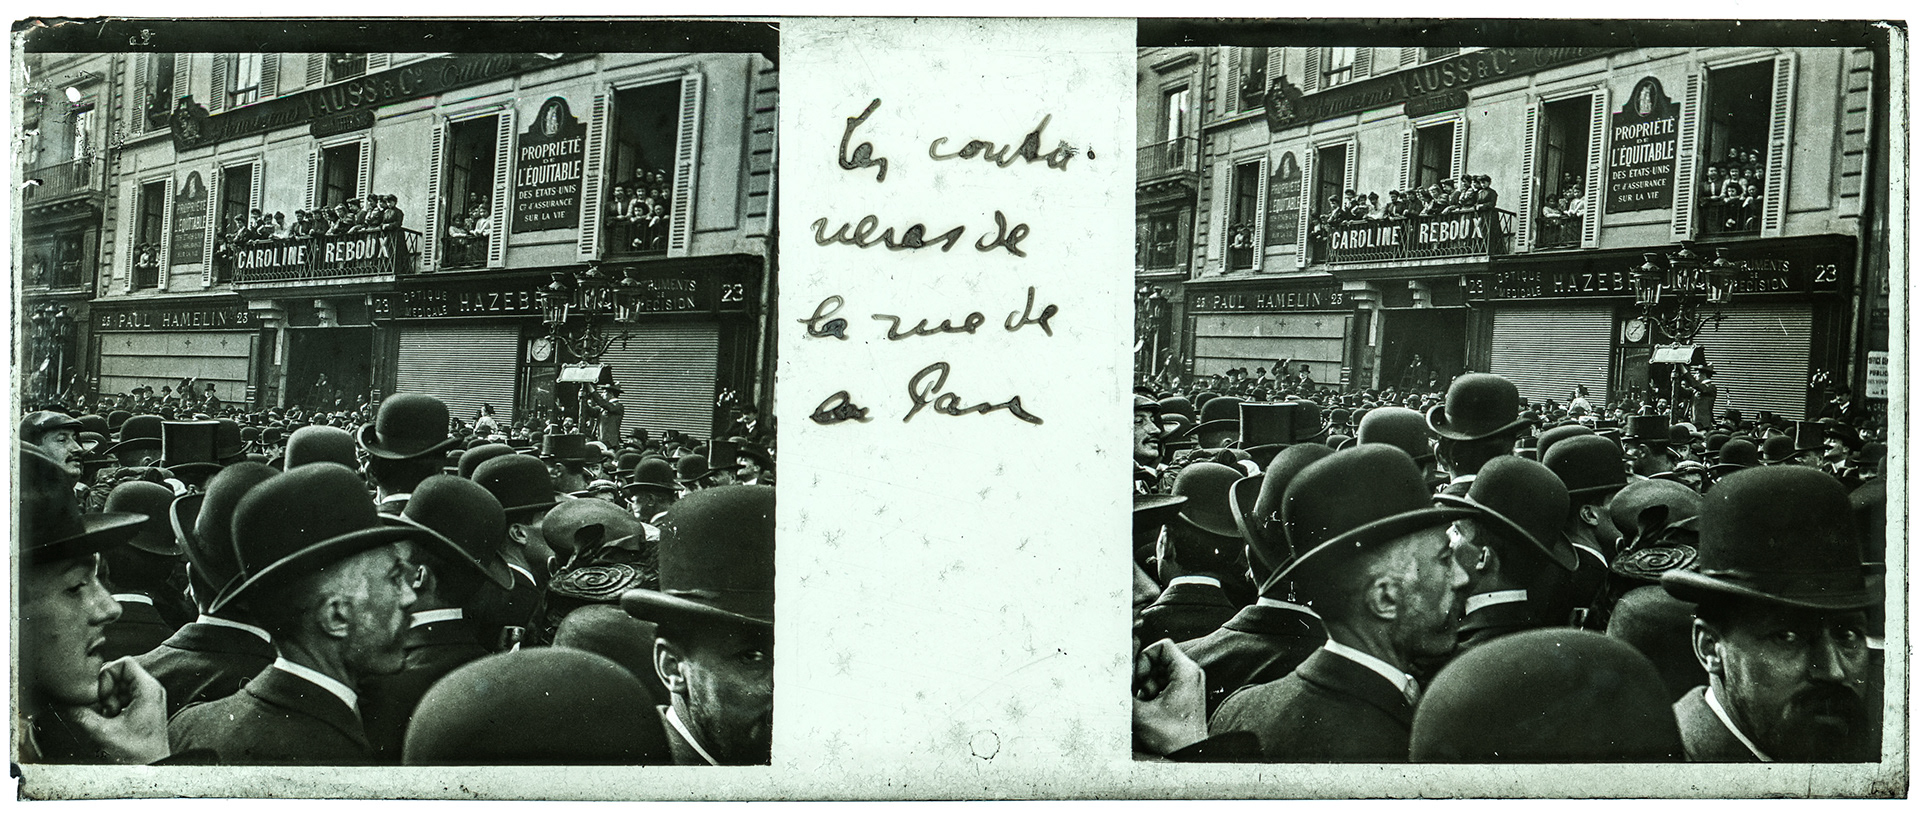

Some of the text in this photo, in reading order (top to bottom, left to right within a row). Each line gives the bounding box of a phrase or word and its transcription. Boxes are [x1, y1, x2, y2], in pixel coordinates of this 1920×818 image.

[1476, 60, 1489, 78] &
[383, 80, 395, 98] &
[1615, 116, 1675, 141] PROPRIÉTÉ
[521, 136, 581, 161] PROPRIÉTÉ
[1612, 170, 1627, 180] DES
[518, 190, 533, 200] DES
[1618, 191, 1660, 203] SUR LA VIE
[524, 210, 566, 223] SUR LA VIE
[1331, 215, 1483, 250] CAROLINE REBOUX
[237, 235, 389, 269] CAROLINE REBOUX
[1469, 279, 1484, 294] 23
[1814, 264, 1837, 283] 23
[1498, 271, 1541, 284] OPTIQUE
[375, 298, 390, 313] 23
[721, 283, 744, 302] 23
[404, 289, 448, 303] OPTIQUE
[1213, 295, 1245, 309] PAUL
[1256, 292, 1321, 309] HAMELIN
[1330, 293, 1343, 305] 23
[118, 312, 151, 328] PAUL
[162, 311, 227, 327] HAMELIN
[236, 312, 249, 324] 23
[871, 311, 985, 341] rue
[1004, 286, 1058, 338] de
